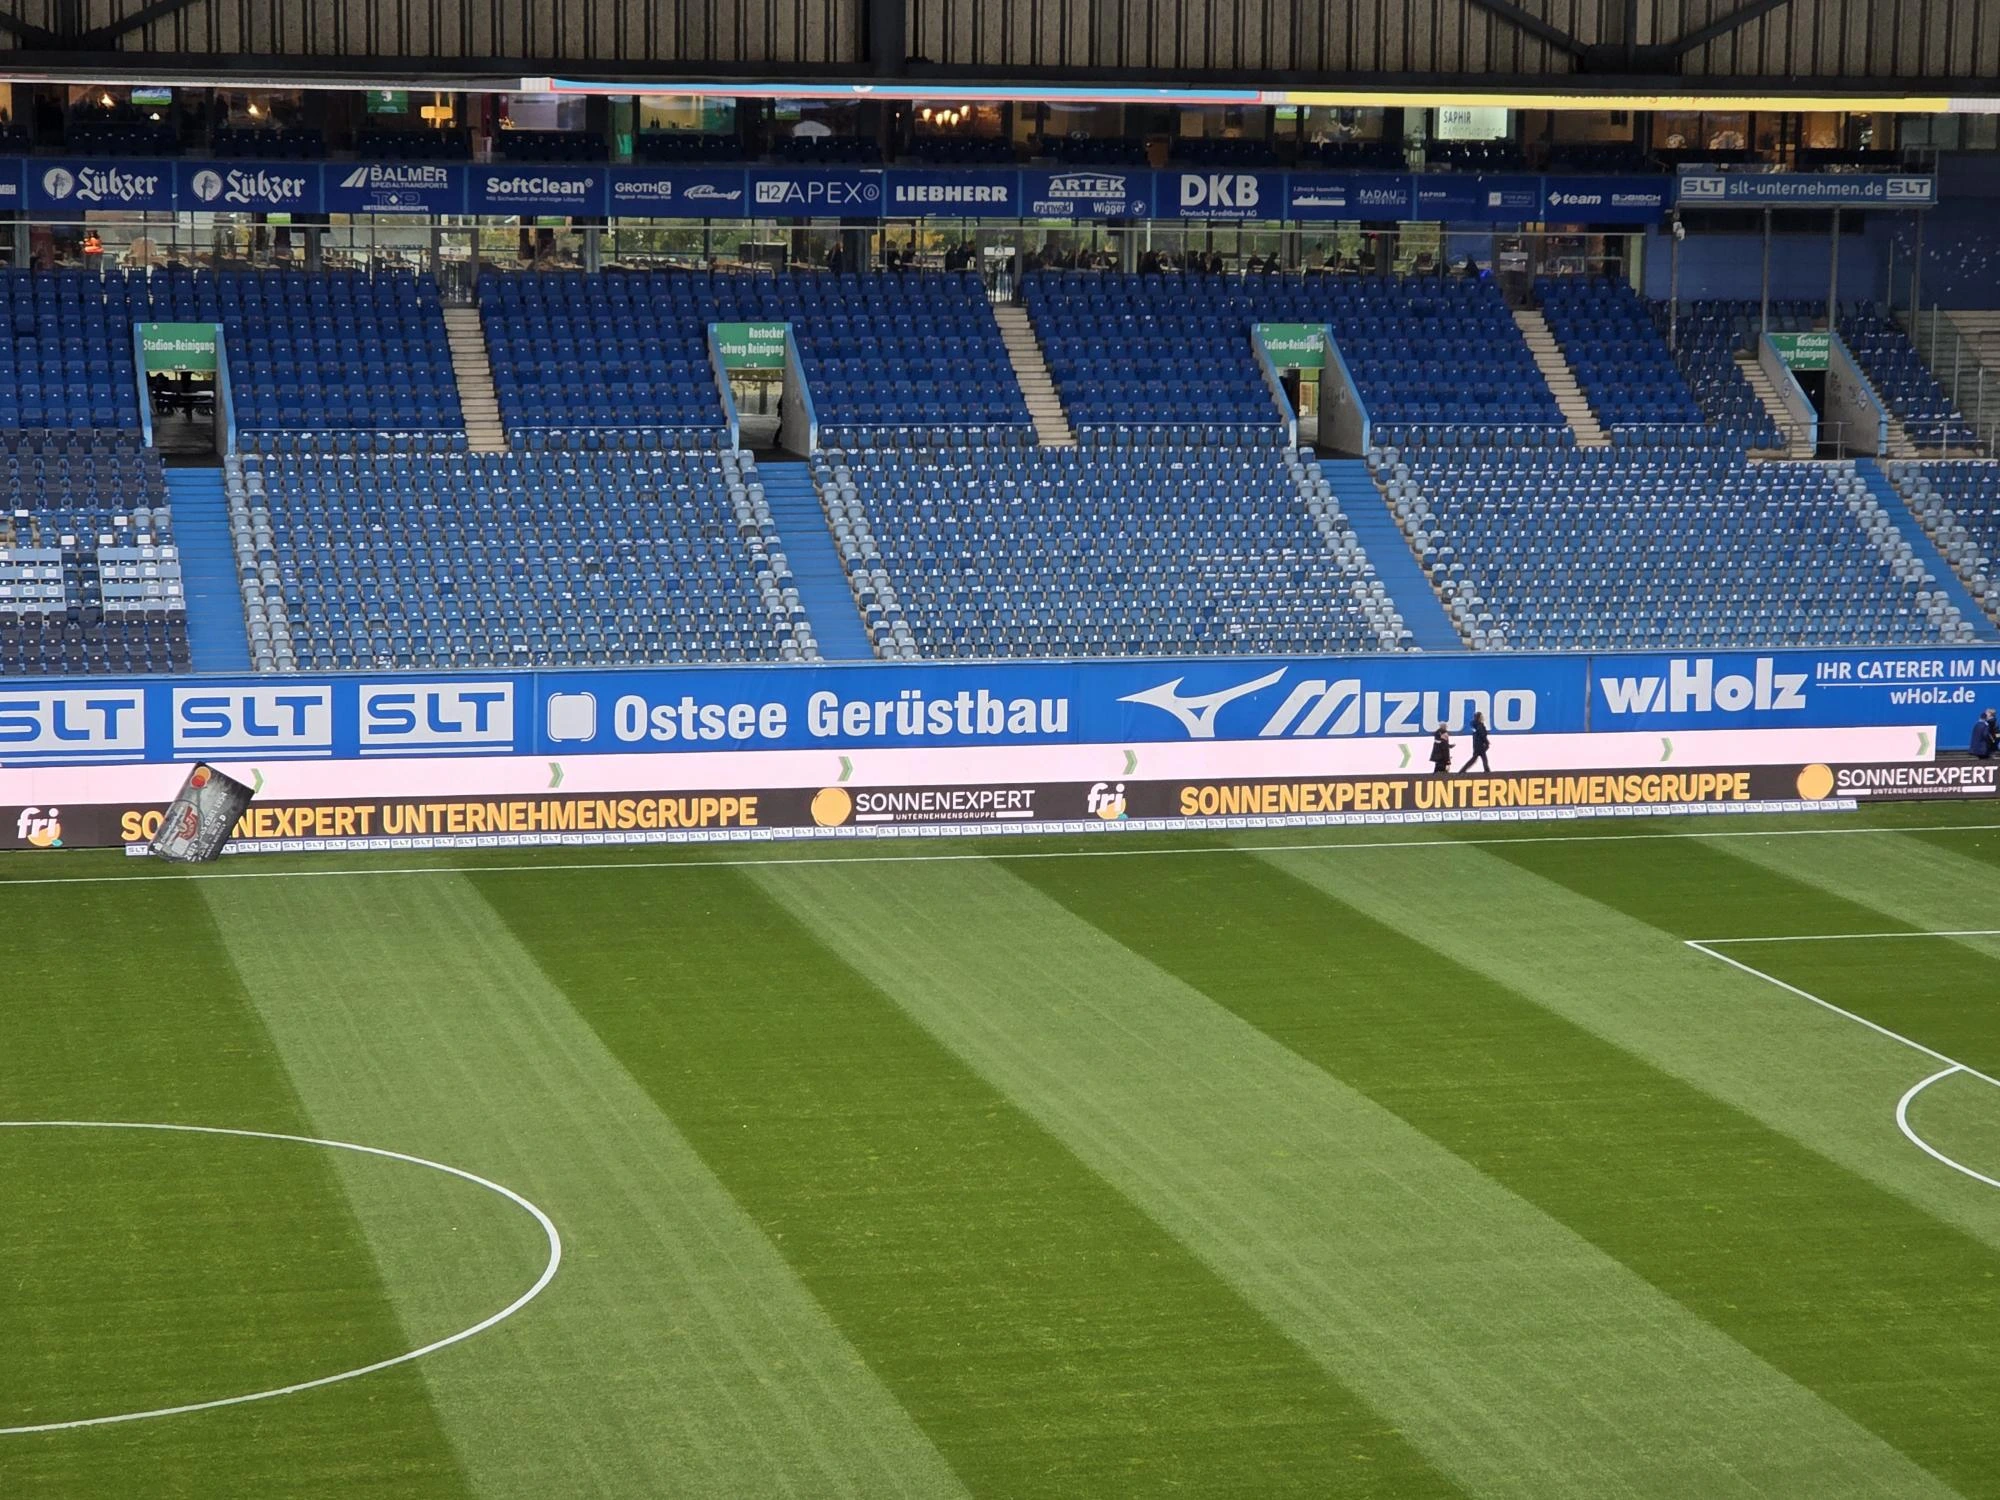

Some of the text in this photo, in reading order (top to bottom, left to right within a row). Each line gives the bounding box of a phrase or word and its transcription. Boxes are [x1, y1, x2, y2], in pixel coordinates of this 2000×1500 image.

[1443, 111, 1472, 124] SAPHIR
[370, 166, 448, 182] BALMER
[76, 166, 158, 202] Lübzer
[225, 169, 306, 204] Lübzer
[614, 182, 657, 193] GROTH
[1049, 179, 1125, 191] ARTEK
[1180, 174, 1258, 207] DKB
[1683, 180, 1722, 192] SLT
[1730, 182, 1882, 196] slt-unternehmen.de
[1888, 181, 1929, 194] SLT
[896, 185, 1008, 202] LIEBHERR
[1360, 189, 1397, 199] RADAU
[1563, 194, 1602, 204] team
[1093, 202, 1125, 216] Wigger
[1180, 209, 1209, 217] Deutsche
[749, 326, 784, 339] Rostocker
[143, 339, 215, 354] Stadion-Reinigung
[748, 342, 784, 357] Reinigung
[1816, 662, 1851, 680] IHR
[1857, 660, 1944, 679] CATERER
[1950, 660, 1974, 677] IM
[1891, 686, 1976, 705] wHolz.de
[0, 699, 135, 742] SLT
[181, 696, 322, 738] SLT
[368, 692, 505, 735] SLT
[614, 690, 1068, 742] Ostsee Gerüstbau
[1836, 766, 1998, 787] SONNENEXPERT
[1088, 782, 1125, 813] fri
[1180, 772, 1750, 816] SONNENEXPERT UNTERNEHMENSGRUPPE
[1873, 786, 1962, 795] UNTERNEHMENSGRUPPE
[856, 789, 1035, 812] SONNENEXPERT
[17, 807, 59, 840] fri
[121, 805, 376, 841] SONEXPERT
[383, 796, 758, 835] UNTERNEHMENSGRUPPE
[896, 811, 996, 821] UNTERNEHMENSGRUPPE
